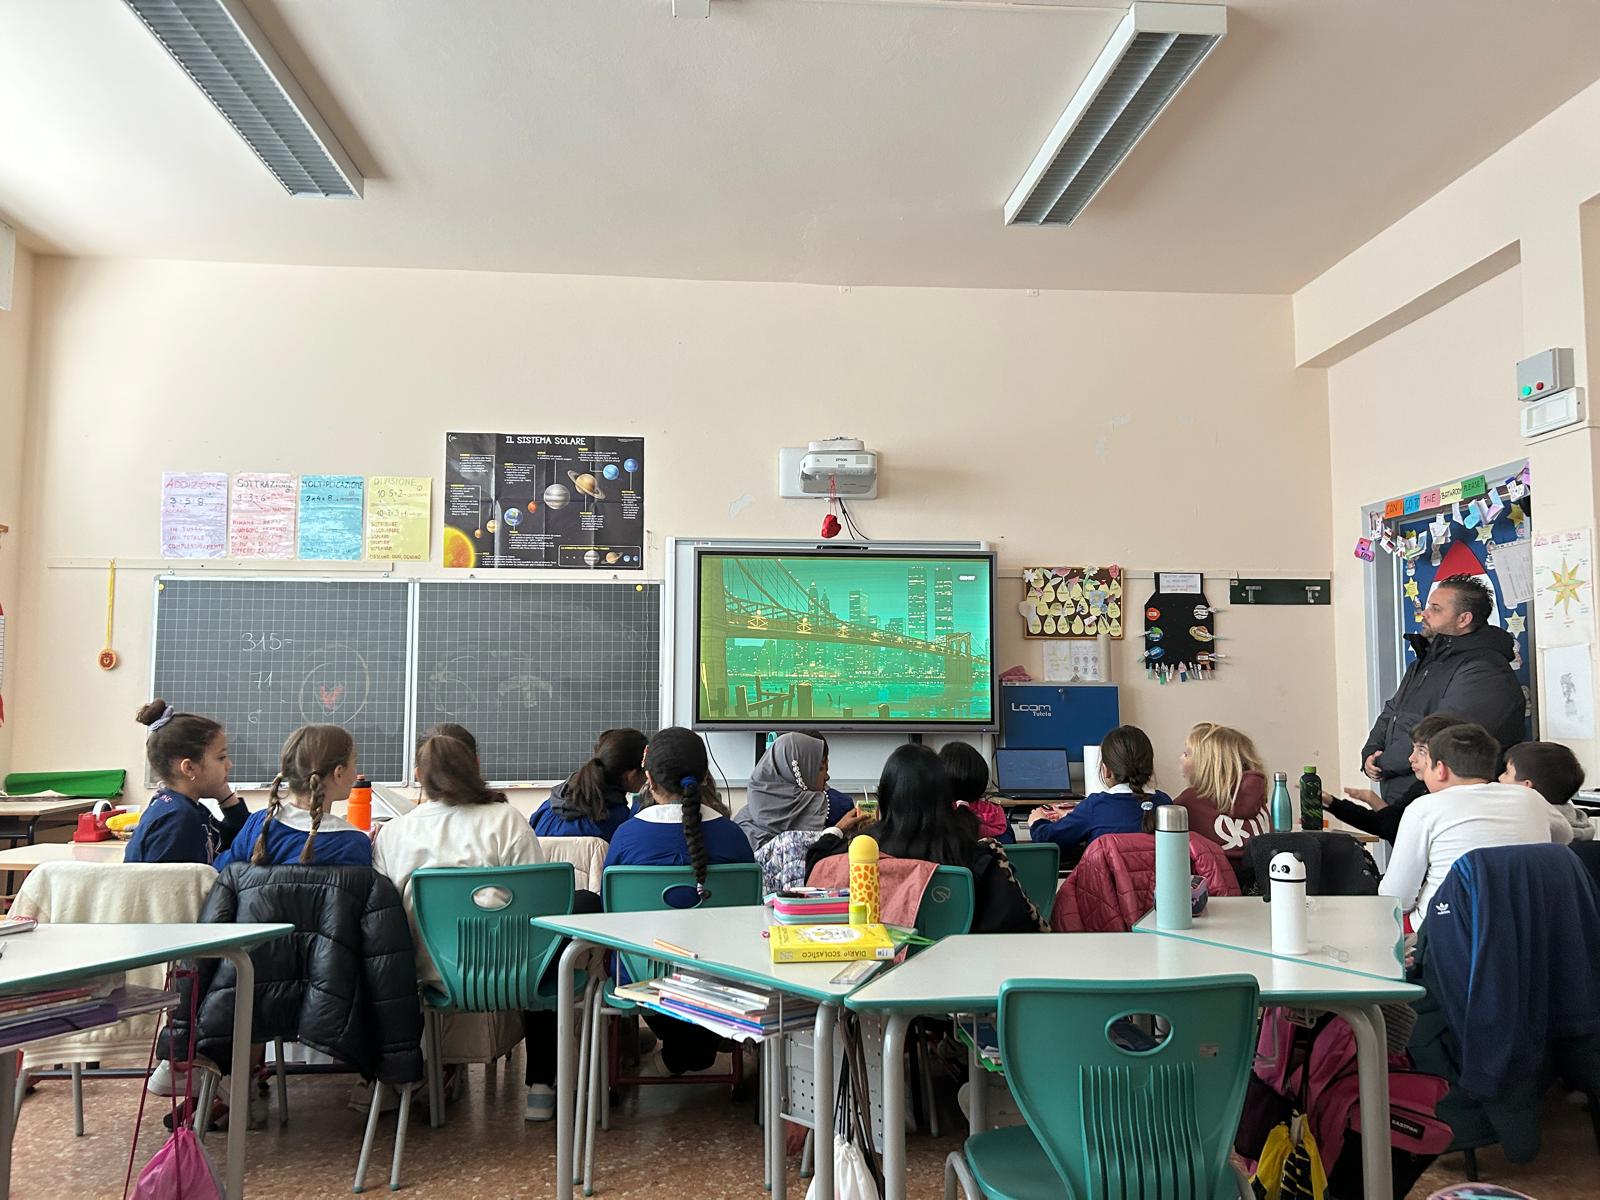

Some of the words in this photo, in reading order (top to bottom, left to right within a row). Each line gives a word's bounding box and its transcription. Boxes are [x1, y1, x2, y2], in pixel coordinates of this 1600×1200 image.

[505, 436, 515, 444] IL
[516, 436, 552, 445] SISTEMA
[554, 437, 586, 446] SOLARE
[1424, 493, 1437, 505] THE
[802, 950, 841, 959] SCOLASTICO
